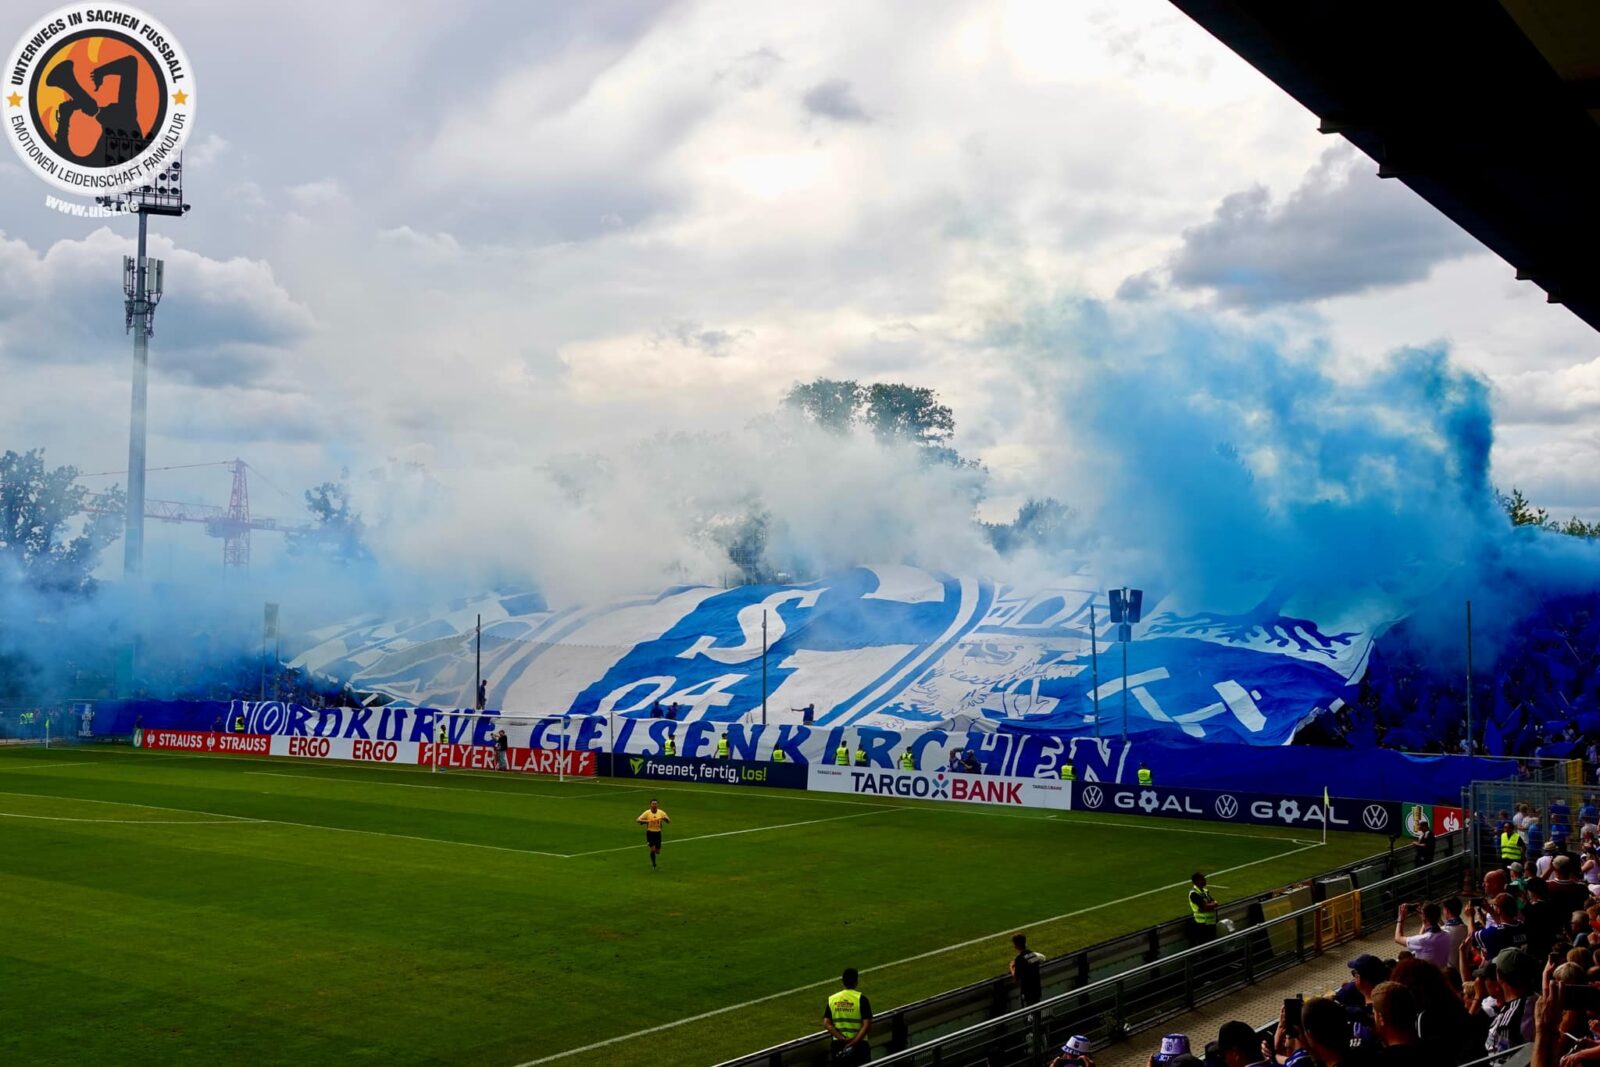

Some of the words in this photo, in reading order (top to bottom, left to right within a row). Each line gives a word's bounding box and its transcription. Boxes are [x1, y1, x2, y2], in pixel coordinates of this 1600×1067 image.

[225, 699, 501, 747] NORDKURVE
[159, 733, 203, 749] STRAUSS
[219, 736, 268, 752] STRAUSS
[288, 736, 331, 758] ERGO
[352, 739, 398, 762] ERGO
[646, 760, 698, 780] freenet,
[700, 763, 739, 783] fertig,
[741, 765, 767, 781] los!
